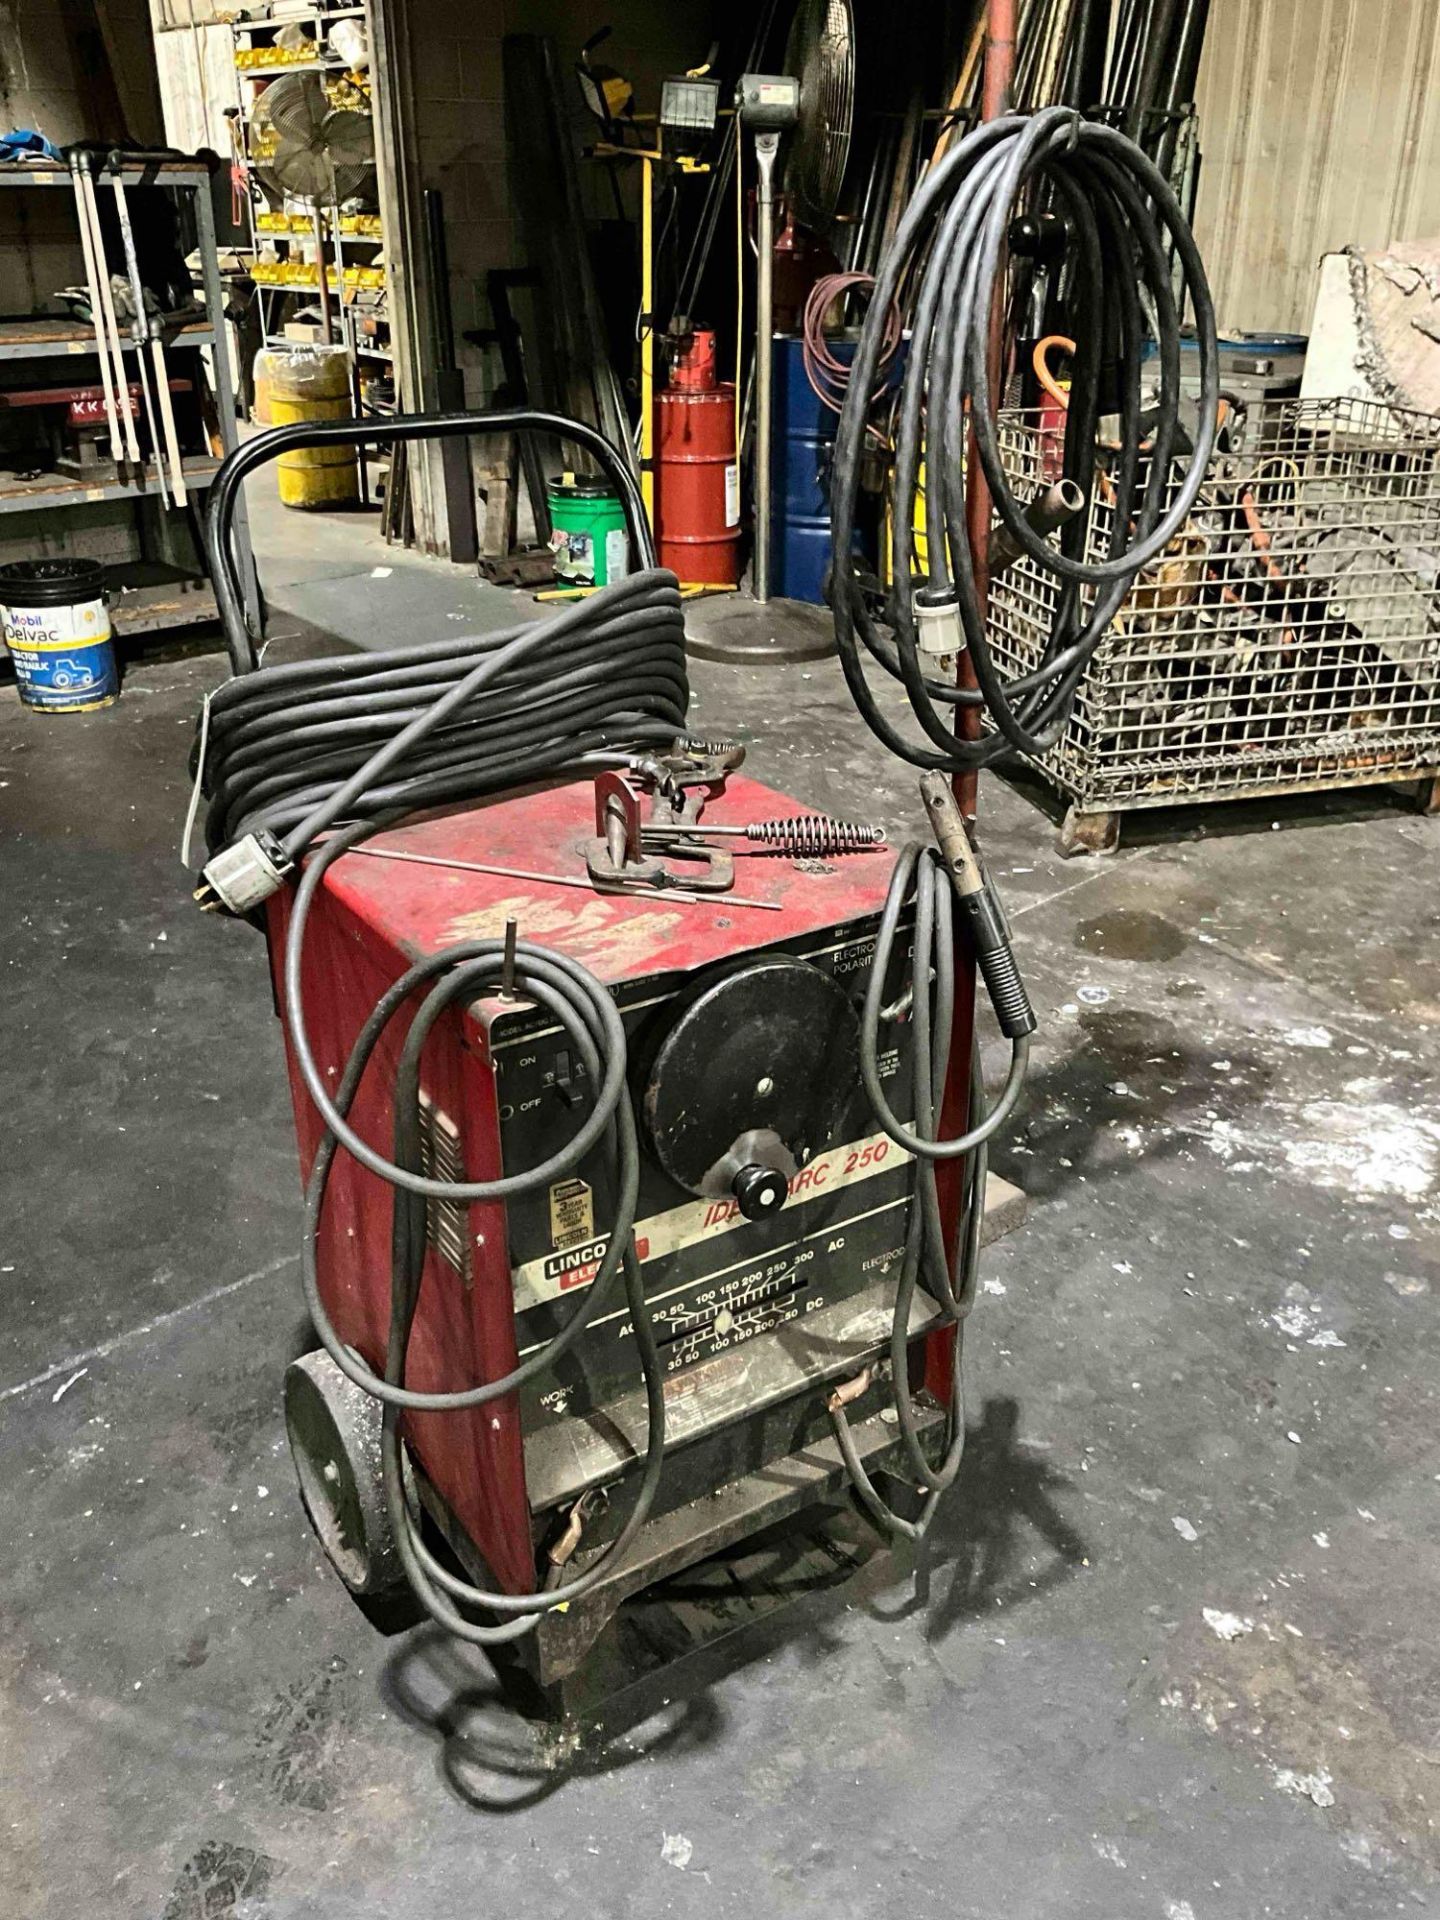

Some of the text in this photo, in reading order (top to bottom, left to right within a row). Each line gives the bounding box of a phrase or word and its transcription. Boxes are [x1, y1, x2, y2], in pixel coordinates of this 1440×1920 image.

[11, 614, 42, 626] Mobil
[6, 623, 59, 641] Delvac
[833, 942, 876, 963] ELECTRO
[833, 955, 873, 976] POLARIT
[520, 1056, 537, 1067] ON
[520, 1098, 542, 1111] OFF
[704, 1141, 889, 1228] IDEARC 250
[549, 1243, 607, 1276] LINCO
[862, 1246, 906, 1272] ELECTROD
[569, 1260, 602, 1283] ELE
[652, 1237, 845, 1323] 30 50 100 150 200 250 300 AC
[667, 1359, 682, 1371] 30
[685, 1352, 700, 1365] 50
[710, 1338, 730, 1352] 100
[733, 1328, 753, 1342] 150
[754, 1319, 775, 1334] 200
[806, 1297, 823, 1312] DC
[540, 1384, 574, 1406] WORK
